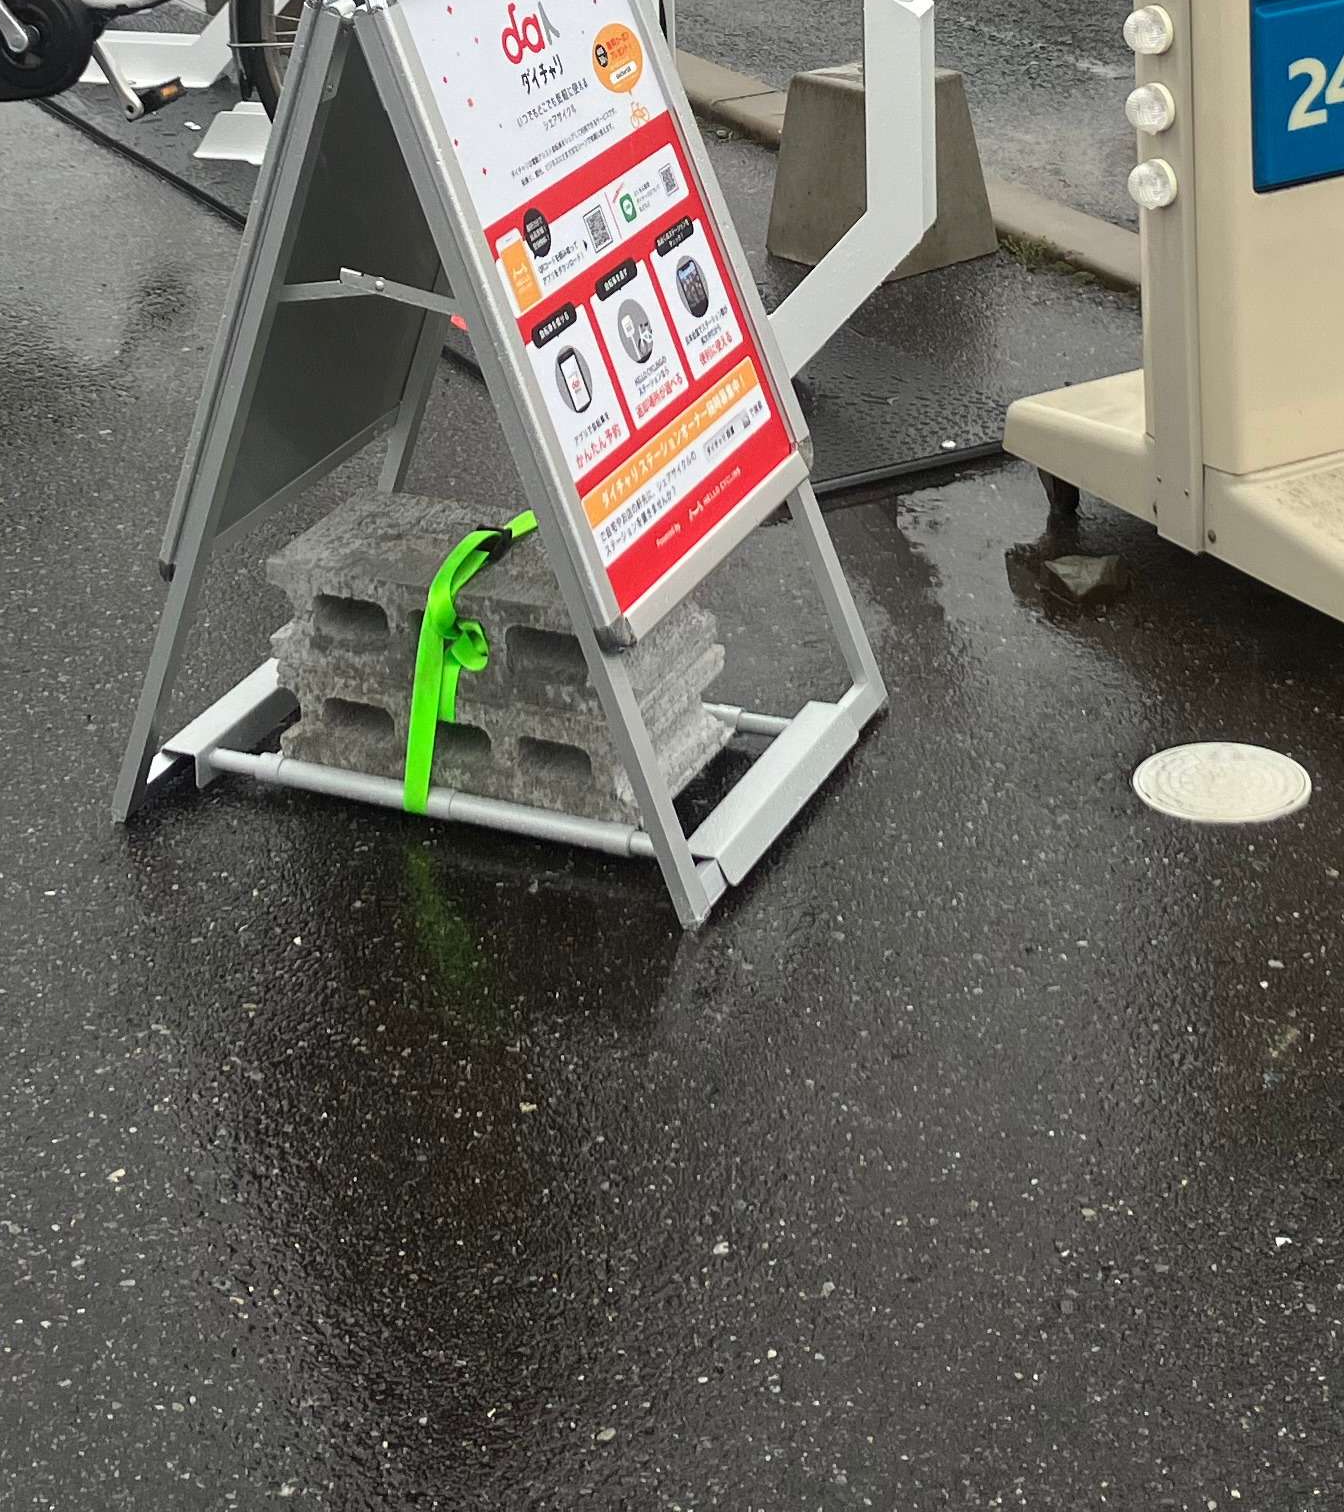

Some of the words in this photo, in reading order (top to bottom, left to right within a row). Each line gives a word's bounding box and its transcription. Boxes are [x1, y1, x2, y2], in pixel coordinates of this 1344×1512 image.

[520, 53, 564, 95] ダイチャリ
[542, 103, 577, 131] シェアサイクル
[698, 330, 733, 366] 便利に使える
[575, 423, 622, 469] かんたん予約
